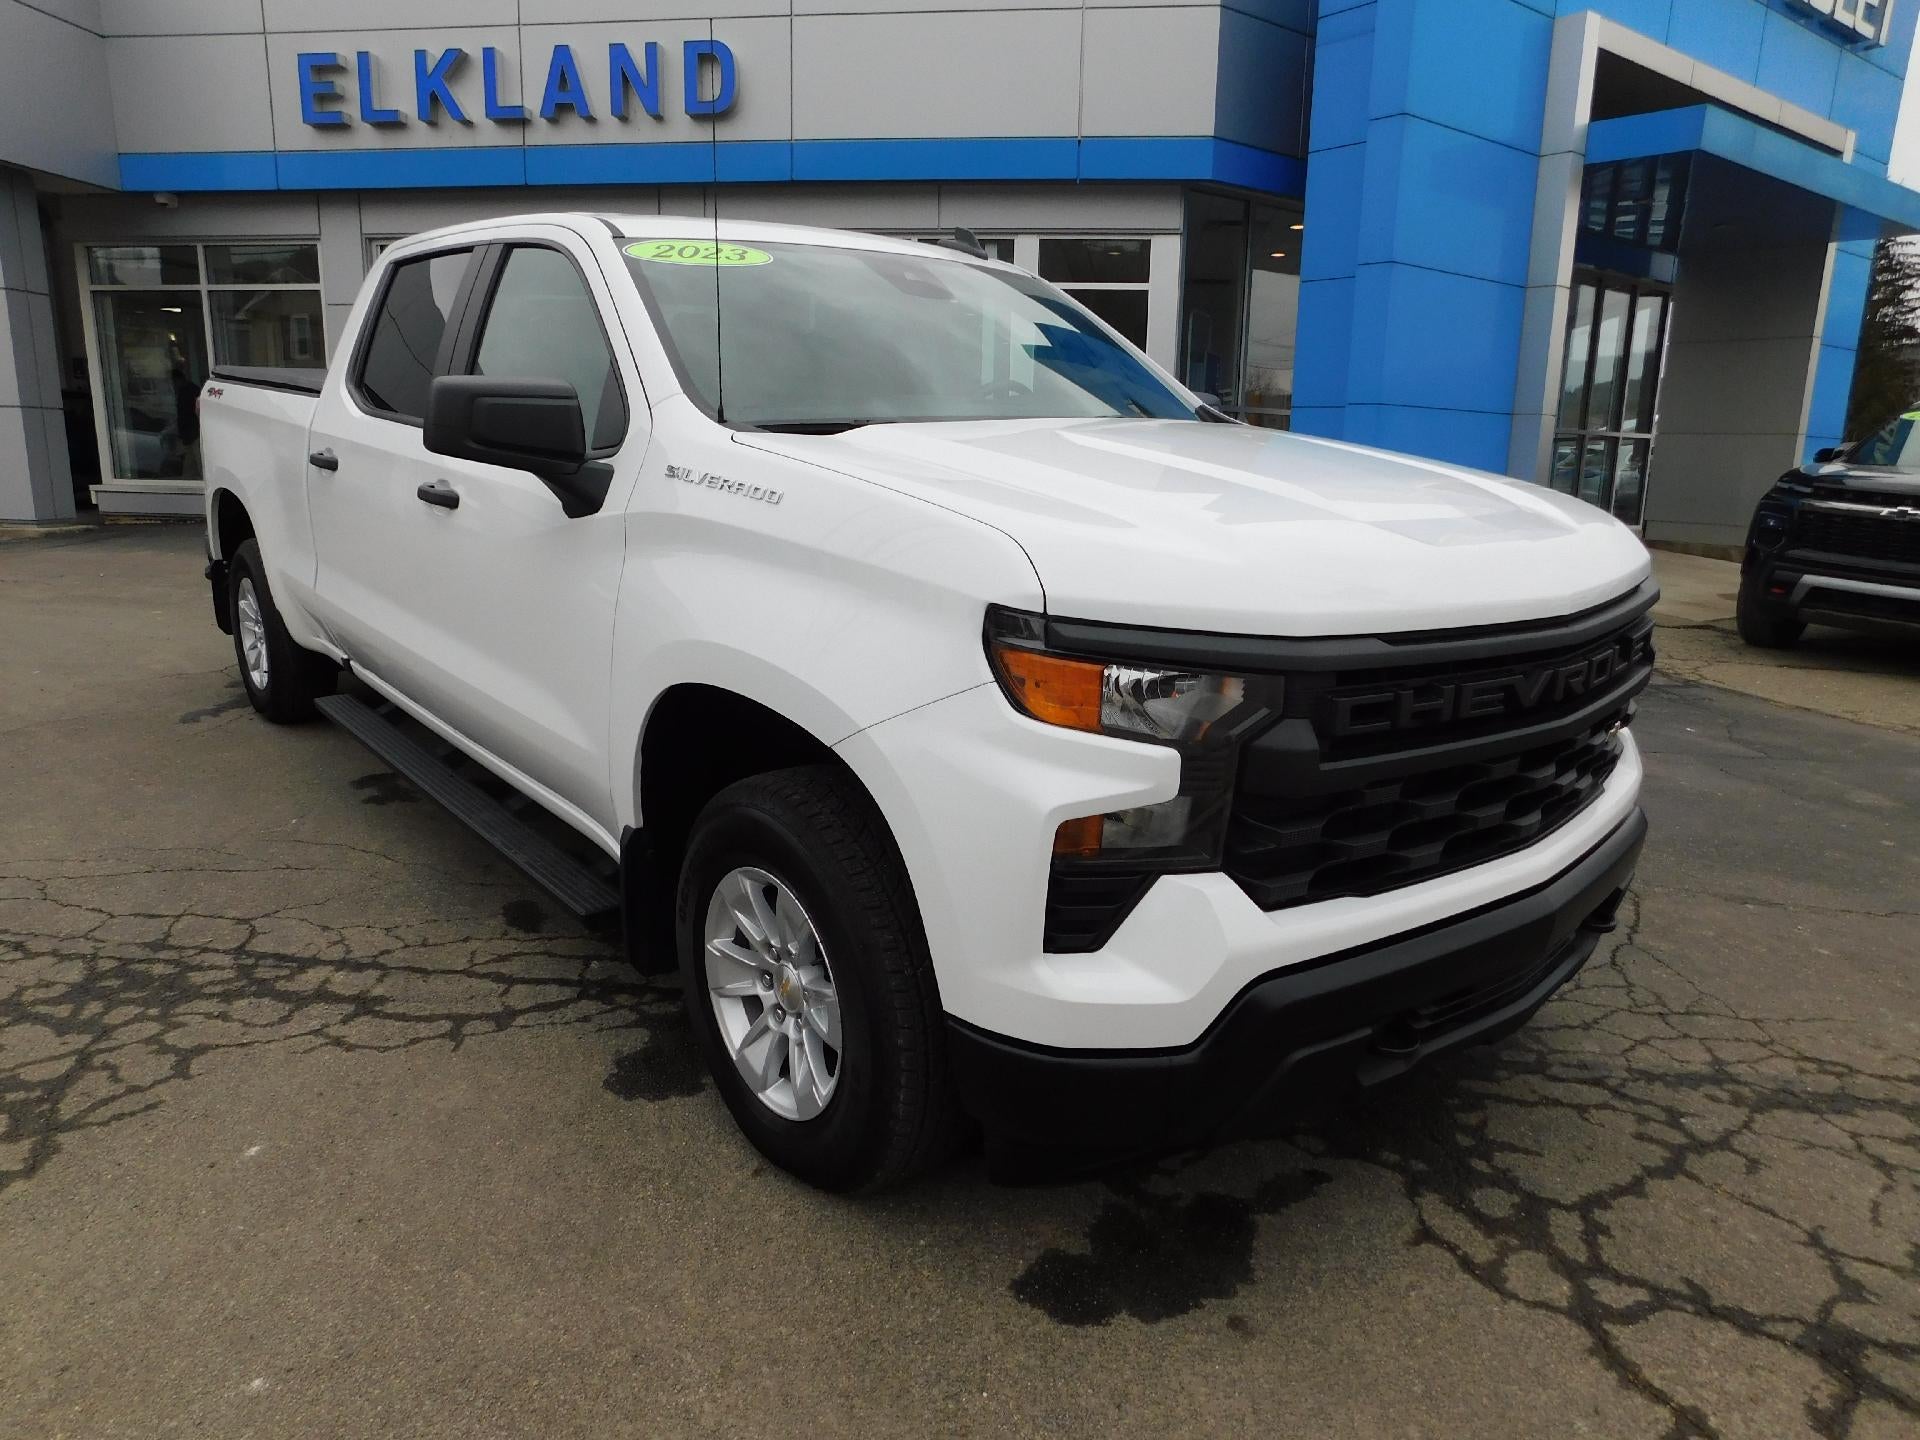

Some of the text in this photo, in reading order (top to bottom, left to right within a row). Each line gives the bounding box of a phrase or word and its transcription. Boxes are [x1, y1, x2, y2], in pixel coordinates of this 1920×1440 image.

[297, 40, 740, 127] ELKLAND
[651, 244, 749, 262] 2023
[664, 464, 785, 506] SILVERADO
